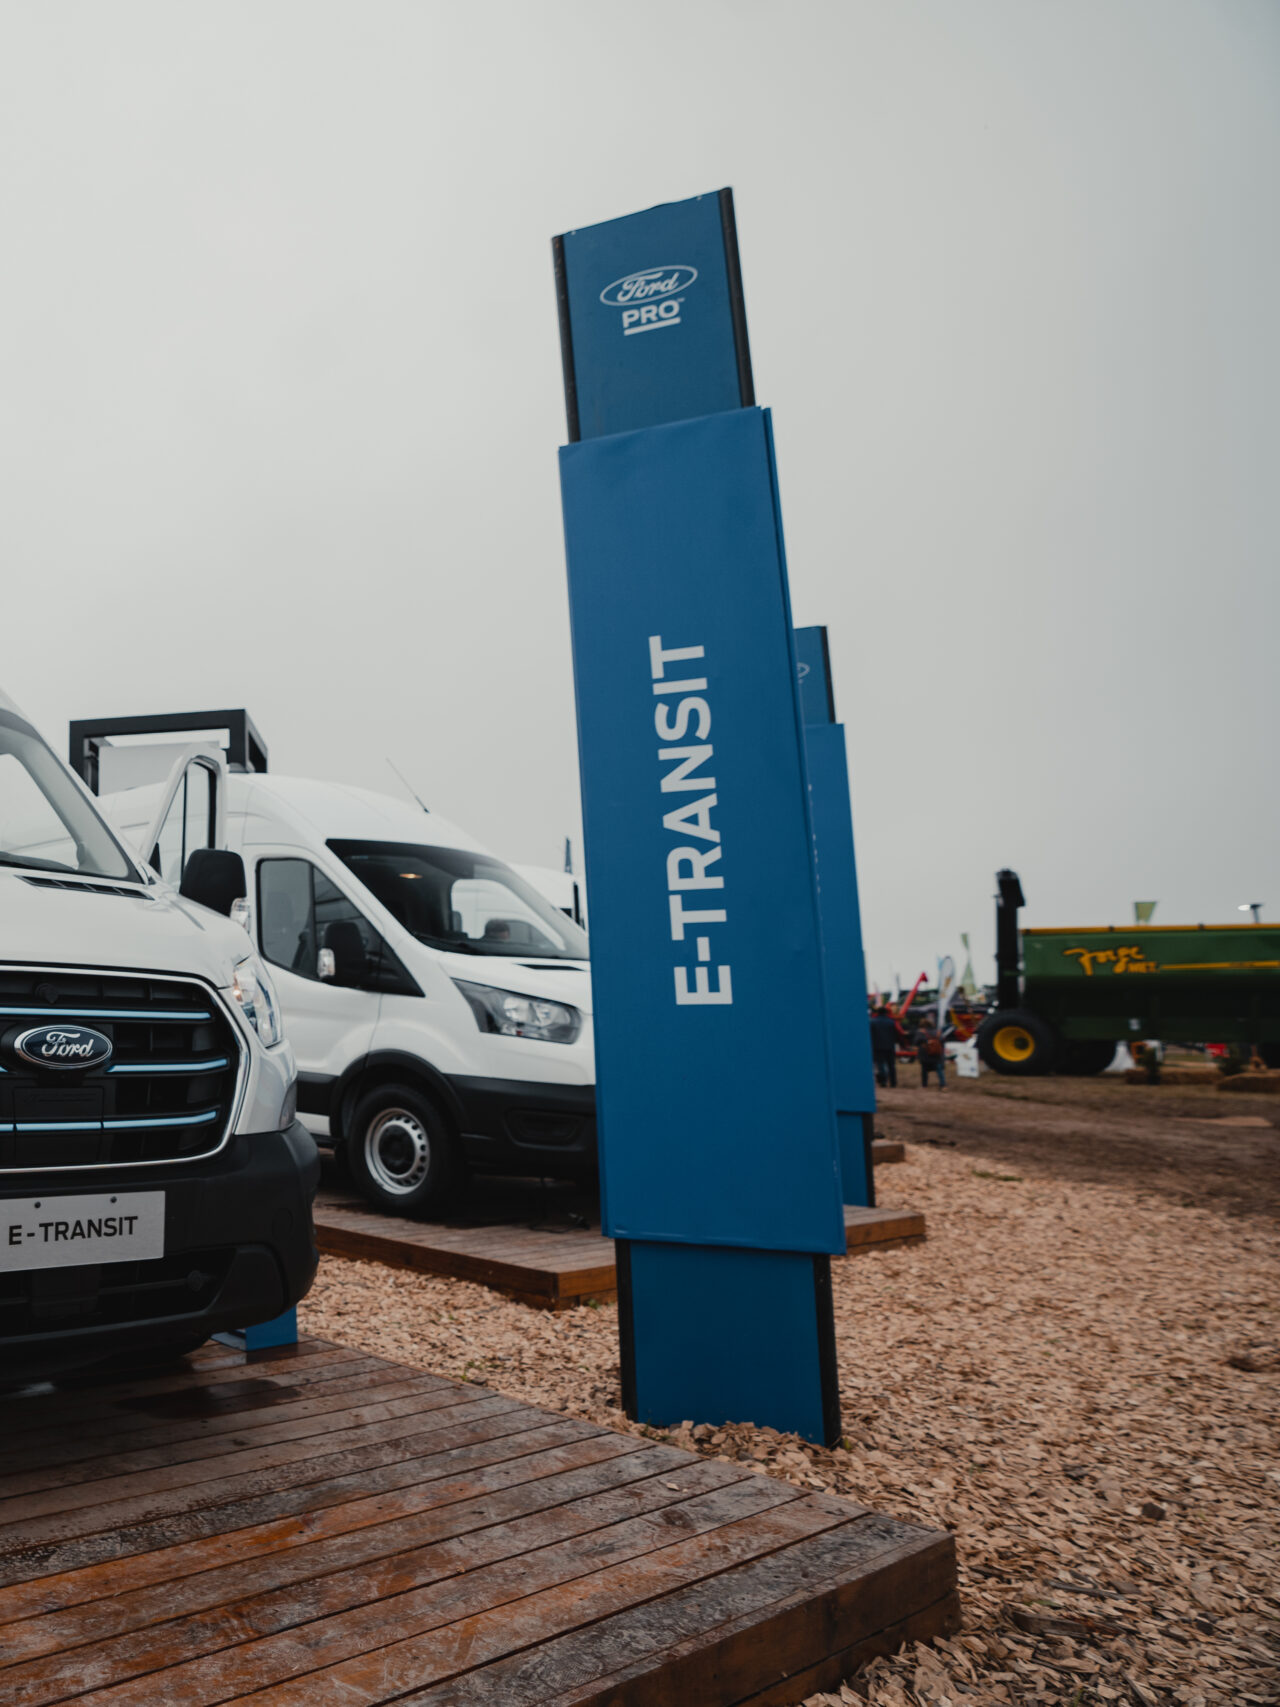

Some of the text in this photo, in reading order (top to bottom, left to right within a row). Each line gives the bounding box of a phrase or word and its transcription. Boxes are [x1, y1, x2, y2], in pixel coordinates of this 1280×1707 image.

[616, 270, 680, 302] Ford
[649, 635, 733, 1005] E-TRANSIT
[41, 1031, 95, 1058] Ford
